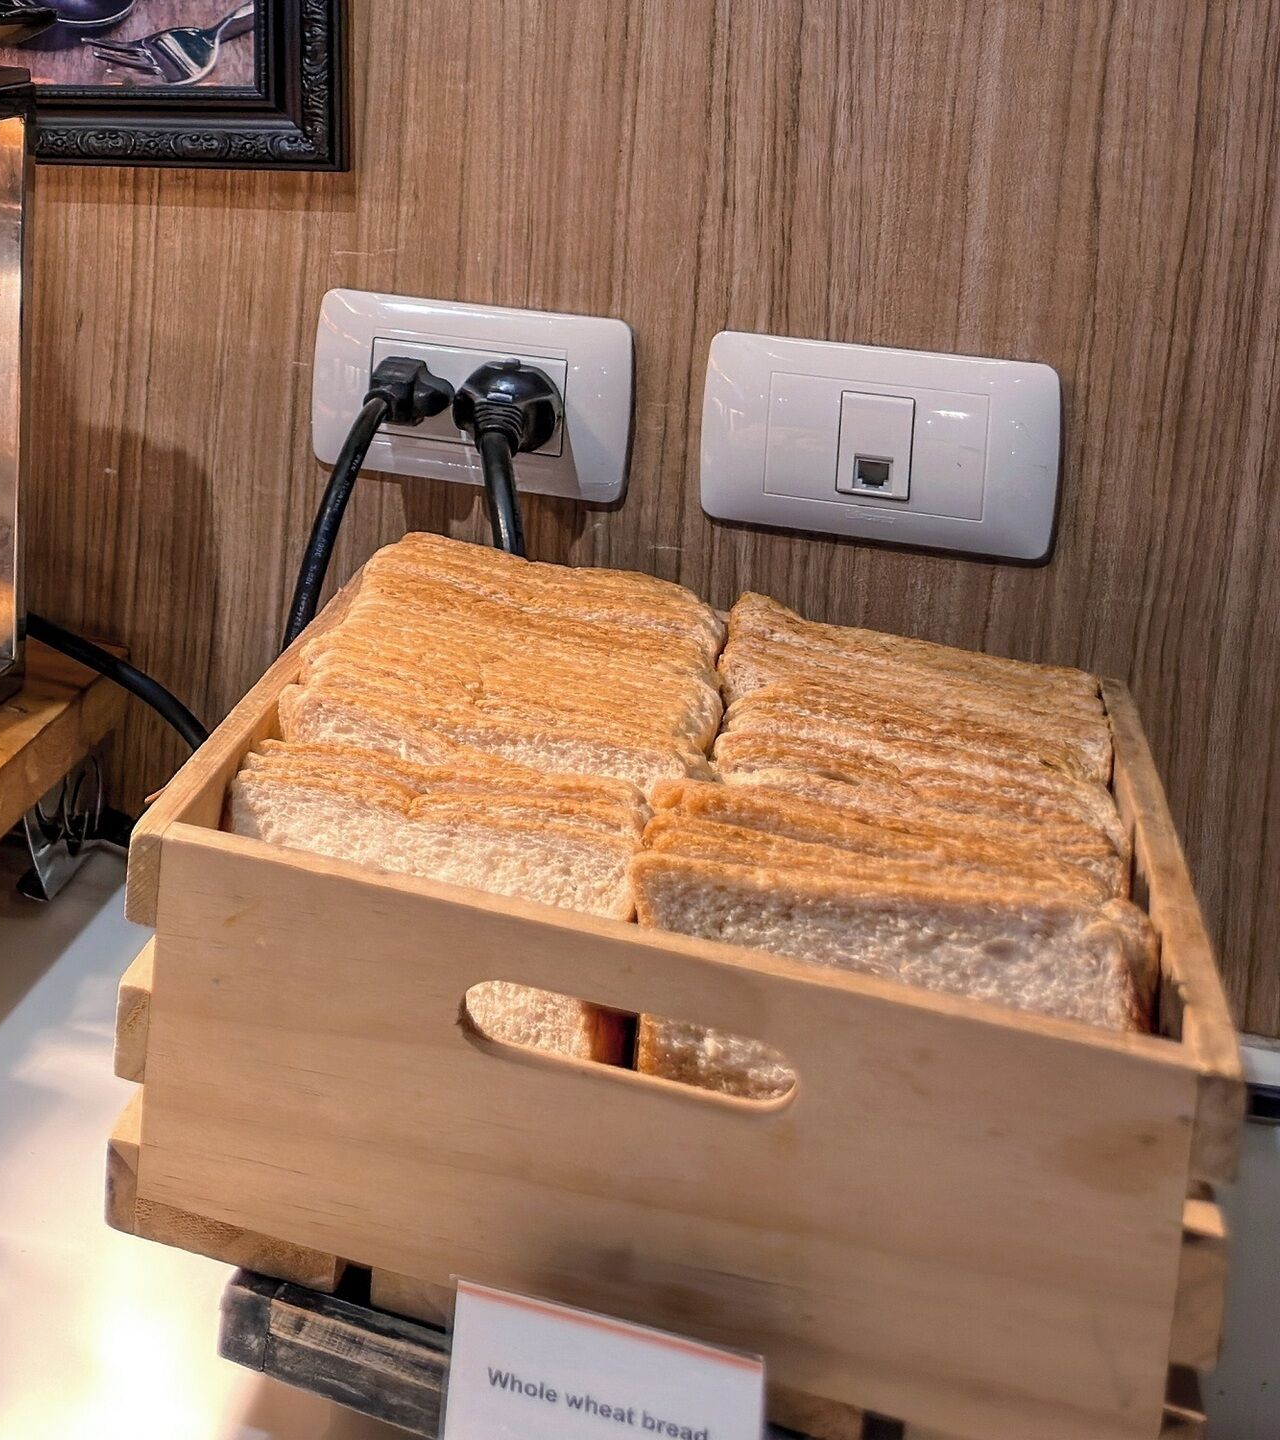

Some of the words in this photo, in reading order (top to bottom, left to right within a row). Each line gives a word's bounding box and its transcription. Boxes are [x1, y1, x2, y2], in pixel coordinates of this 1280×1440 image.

[488, 1366, 558, 1403] Whole
[565, 1391, 635, 1425] wheat
[641, 1410, 708, 1440] bread
